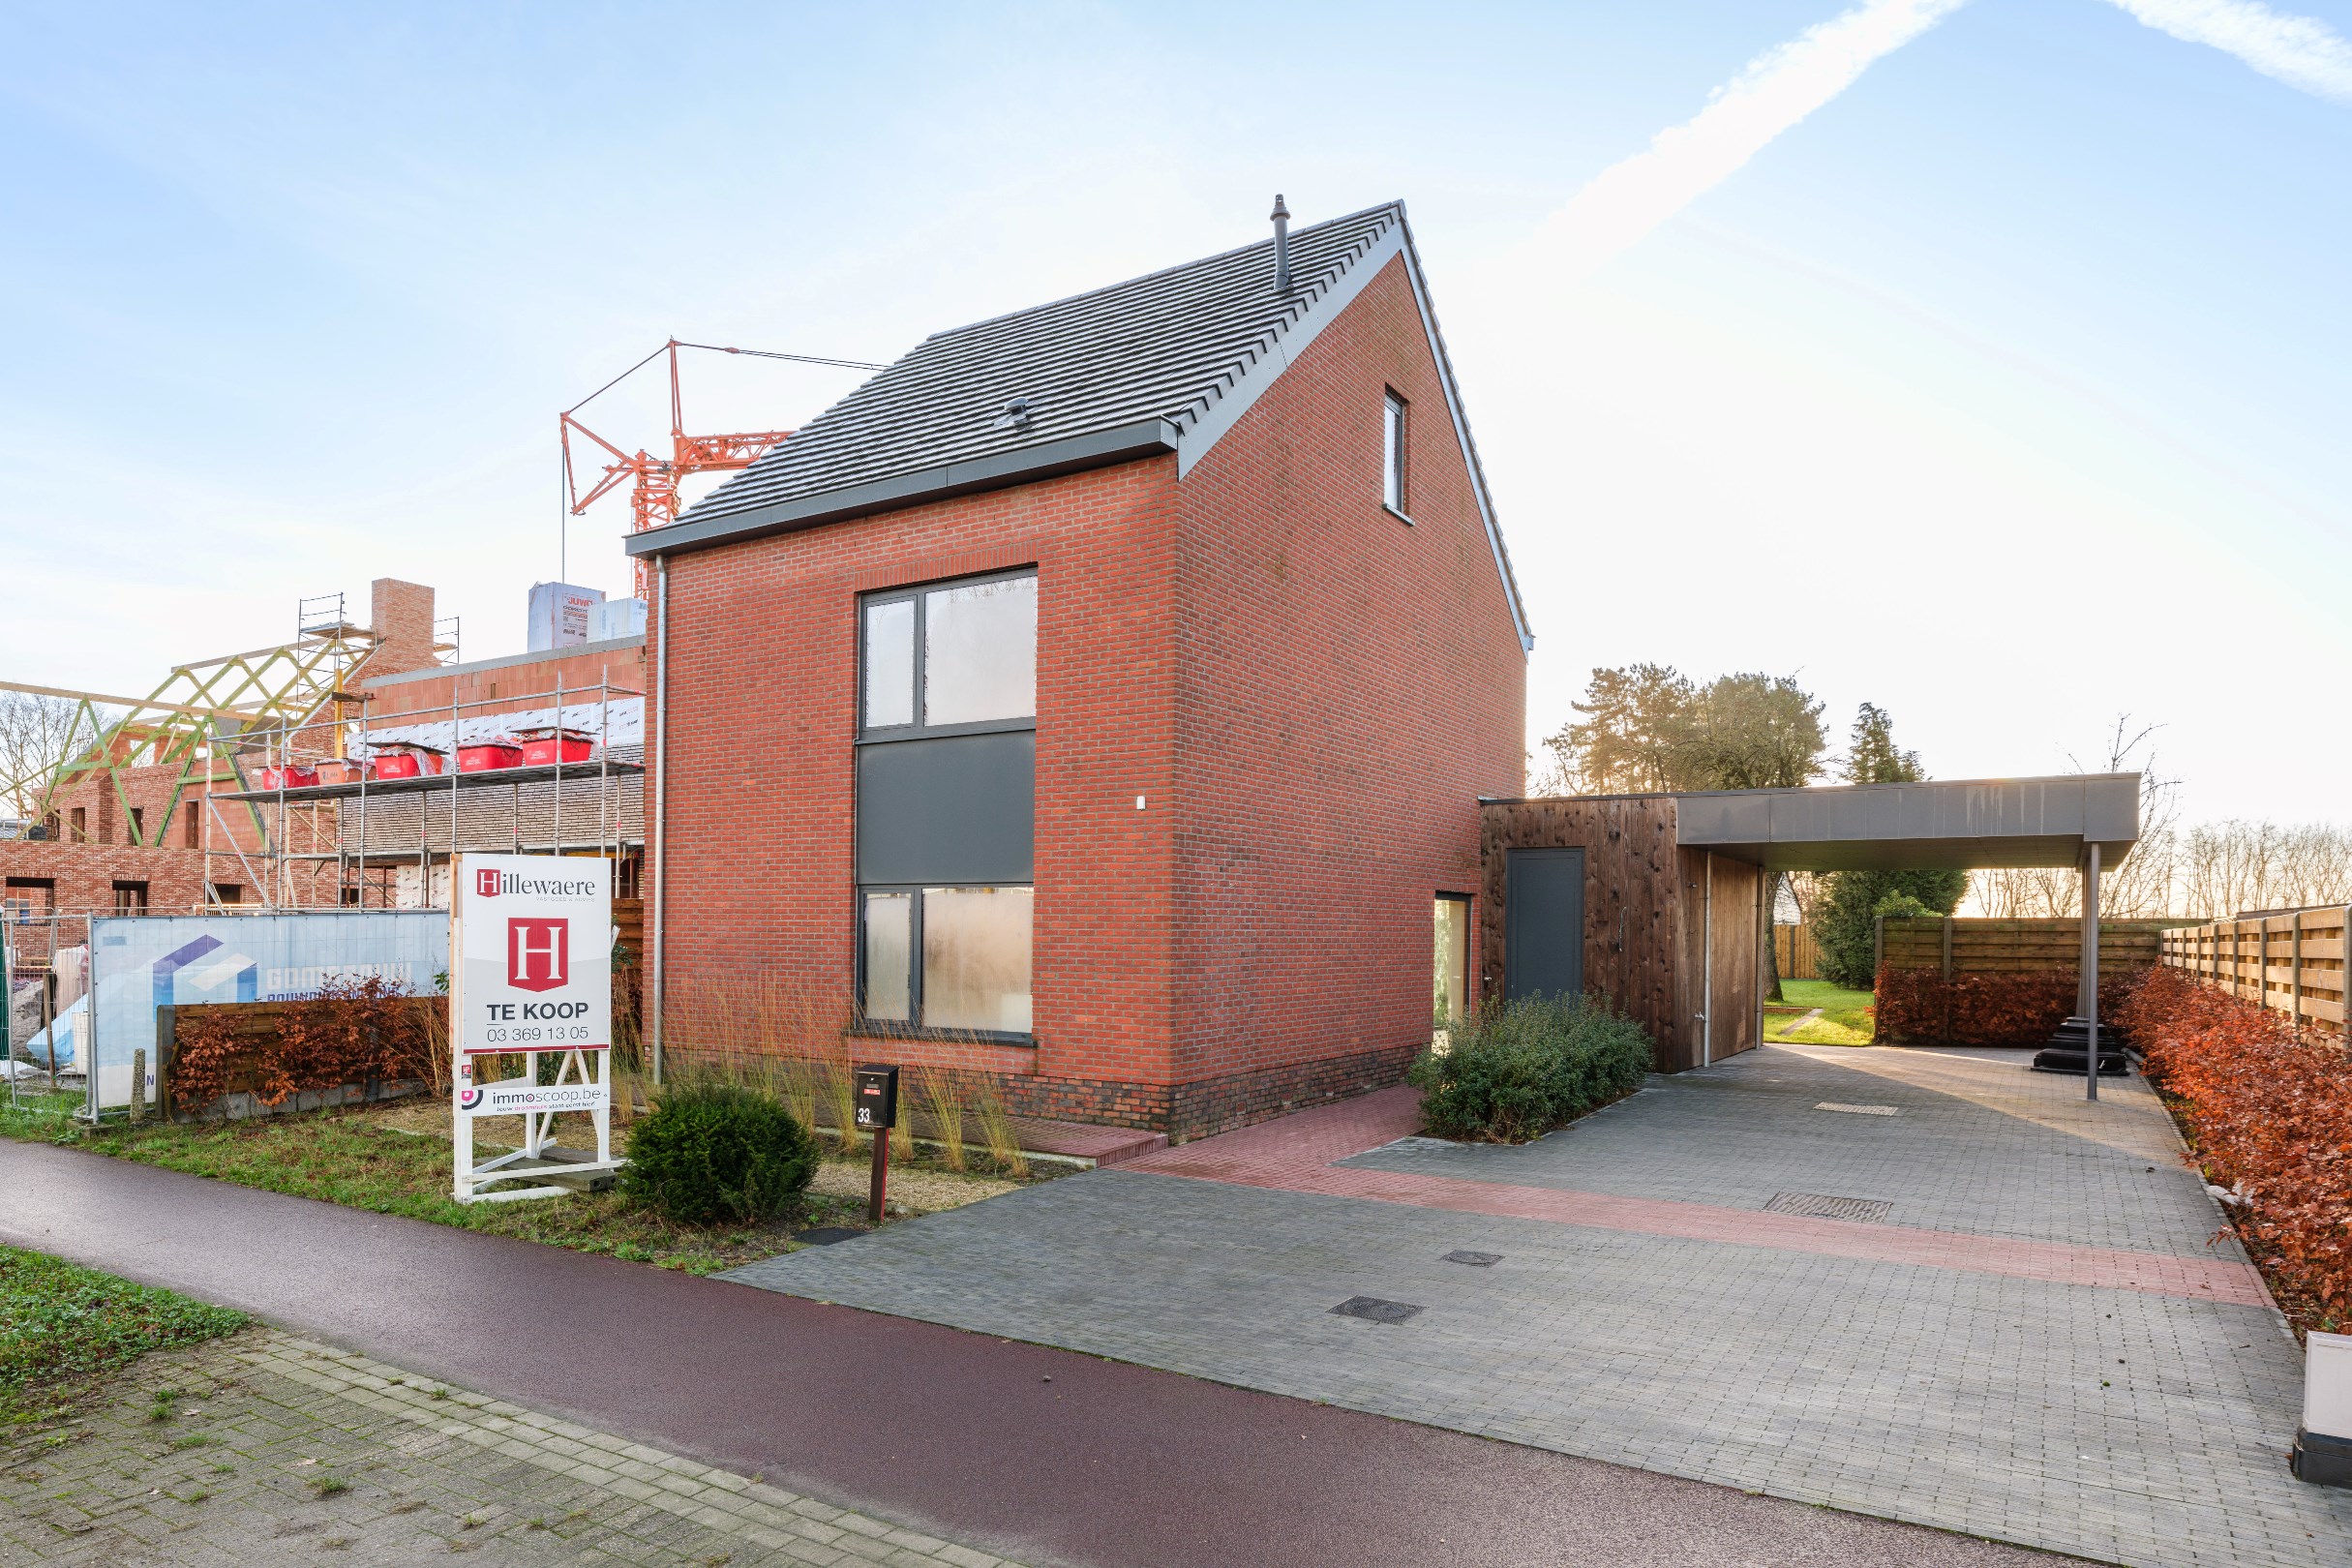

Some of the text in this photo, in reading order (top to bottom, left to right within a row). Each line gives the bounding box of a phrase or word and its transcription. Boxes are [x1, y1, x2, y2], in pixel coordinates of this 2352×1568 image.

[479, 872, 596, 895] Hillewaere
[514, 926, 563, 980] H
[486, 1003, 588, 1021] TE KOOP
[487, 1026, 588, 1042] 03 369 13 05
[493, 1088, 601, 1104] immoscoop.be
[858, 1107, 870, 1123] 33
